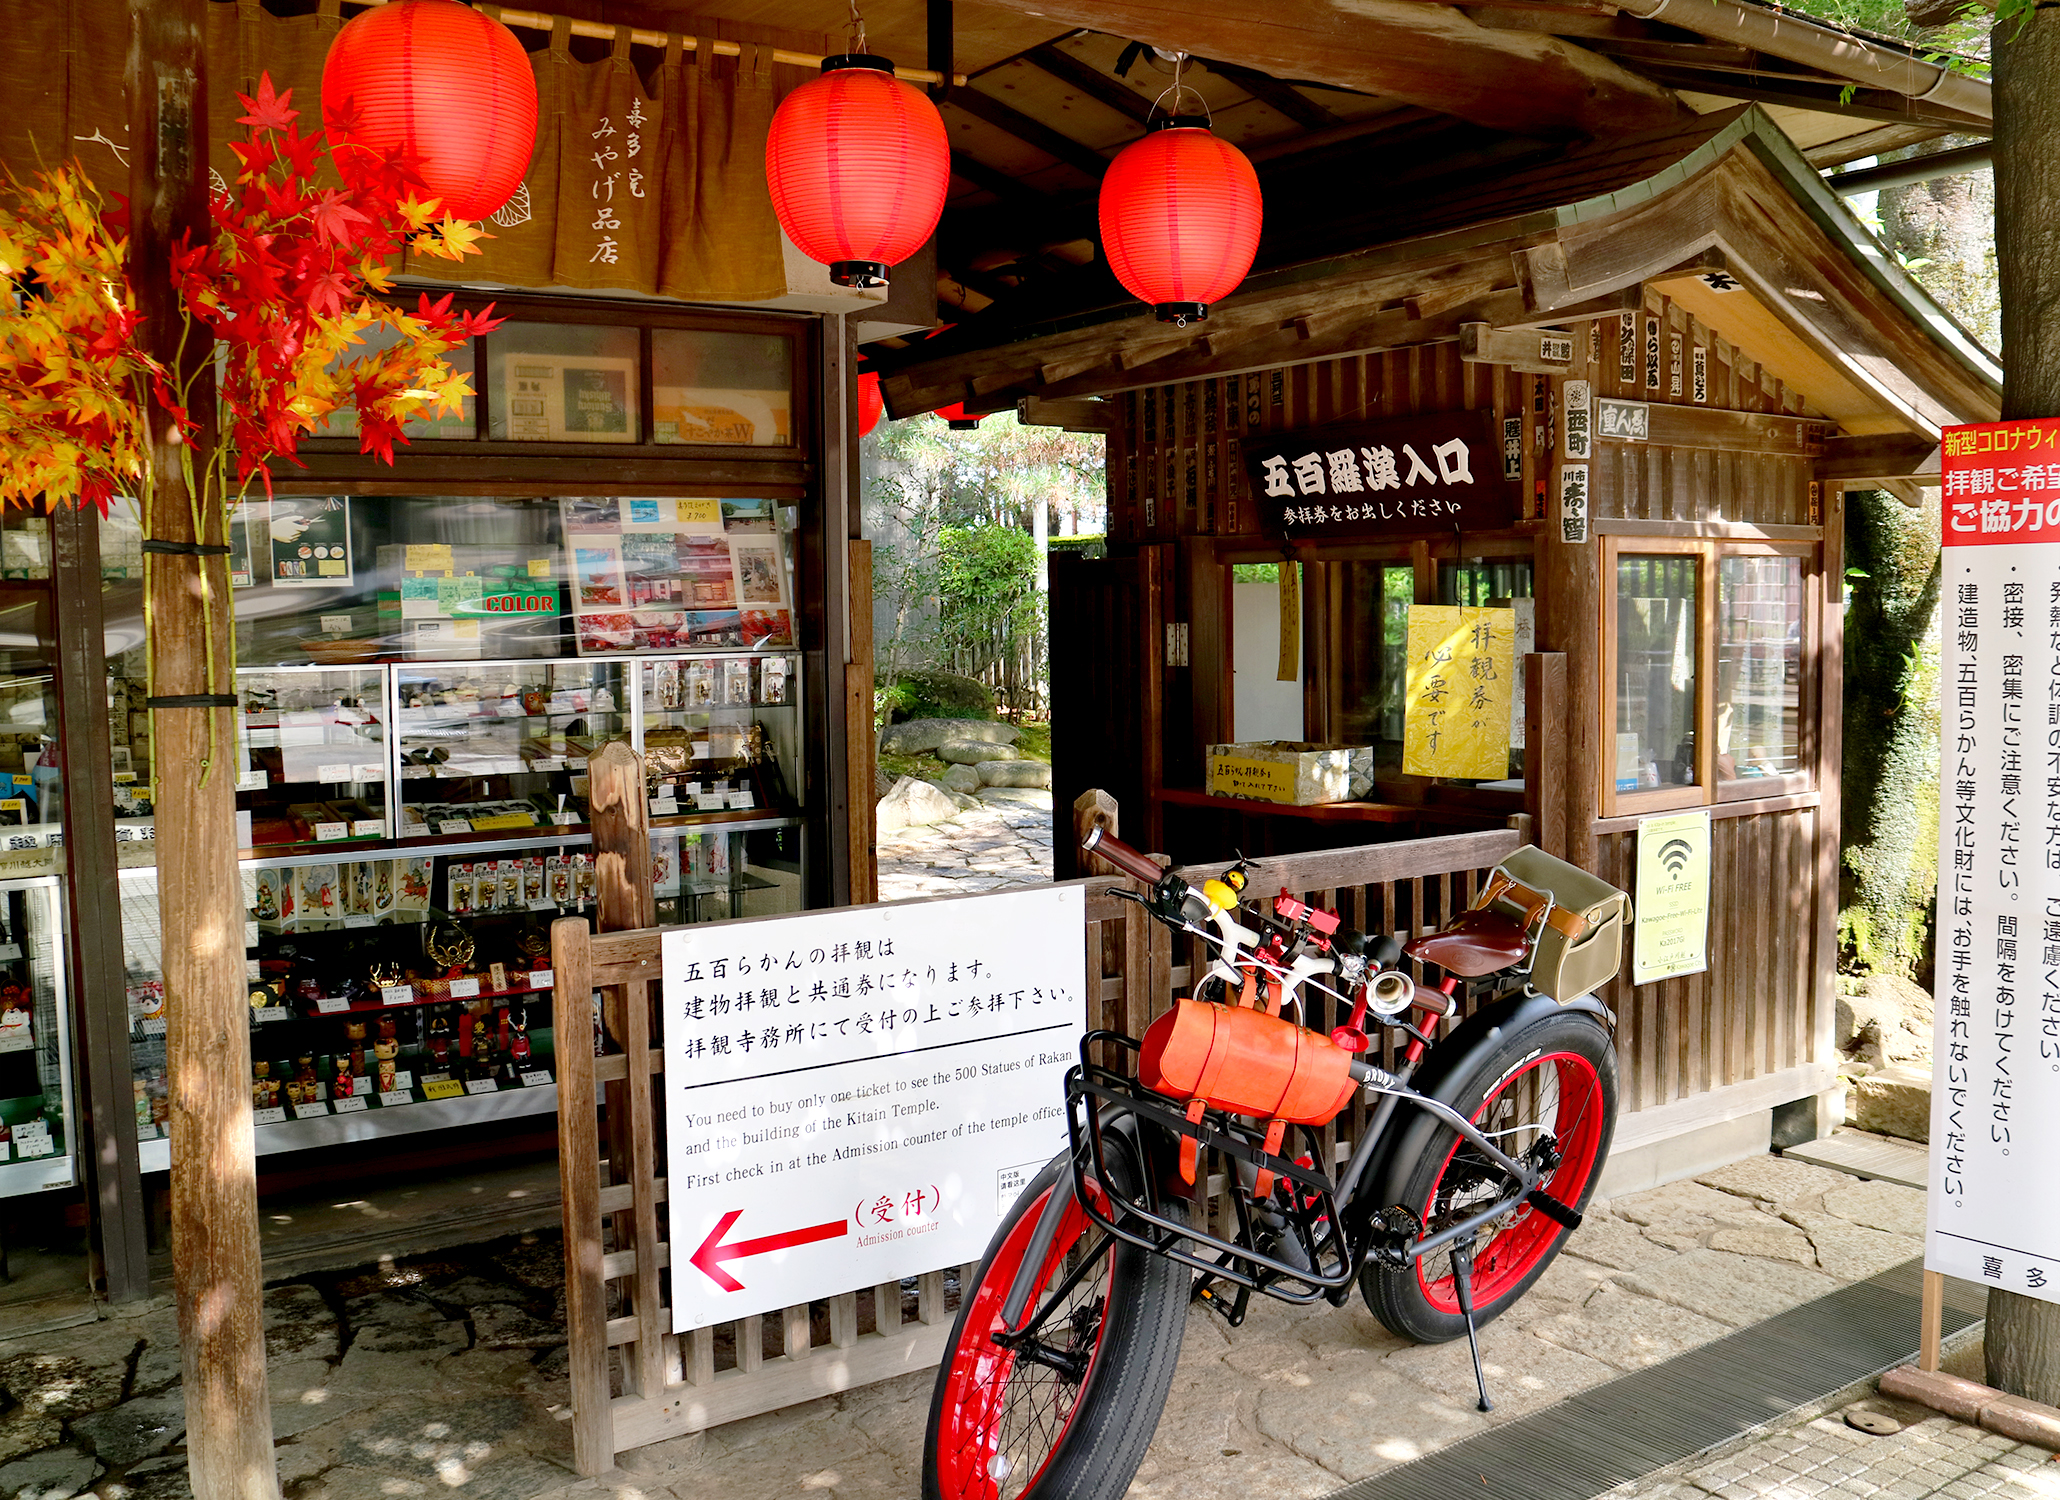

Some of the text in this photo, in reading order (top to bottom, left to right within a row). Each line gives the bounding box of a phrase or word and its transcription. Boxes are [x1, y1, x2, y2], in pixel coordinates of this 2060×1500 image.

[589, 116, 621, 265] みやげ品店
[1262, 438, 1475, 499] 五百羅漢入口
[1283, 501, 1461, 525] 参拝券をお出しください
[1951, 497, 2060, 533] ご協力の
[486, 596, 554, 612] COLOR
[1656, 882, 1692, 895] Wi-Fi FREE
[684, 938, 894, 982] 五百らかんの拝観は
[684, 959, 991, 1020] 建物拝観と共通券になります。
[685, 987, 1073, 1059] 拝観寺務所にて受付の上ご参拝下さい。
[686, 1051, 1072, 1128] You need to buy only one ticket to see the 500 Statues of Rakan
[686, 1099, 939, 1155] and the building of the Kitain Temple.
[687, 1106, 1066, 1189] First check in at the Admission counter of the temple office.
[855, 1184, 940, 1228] (受付)
[856, 1221, 939, 1248] Admission counter
